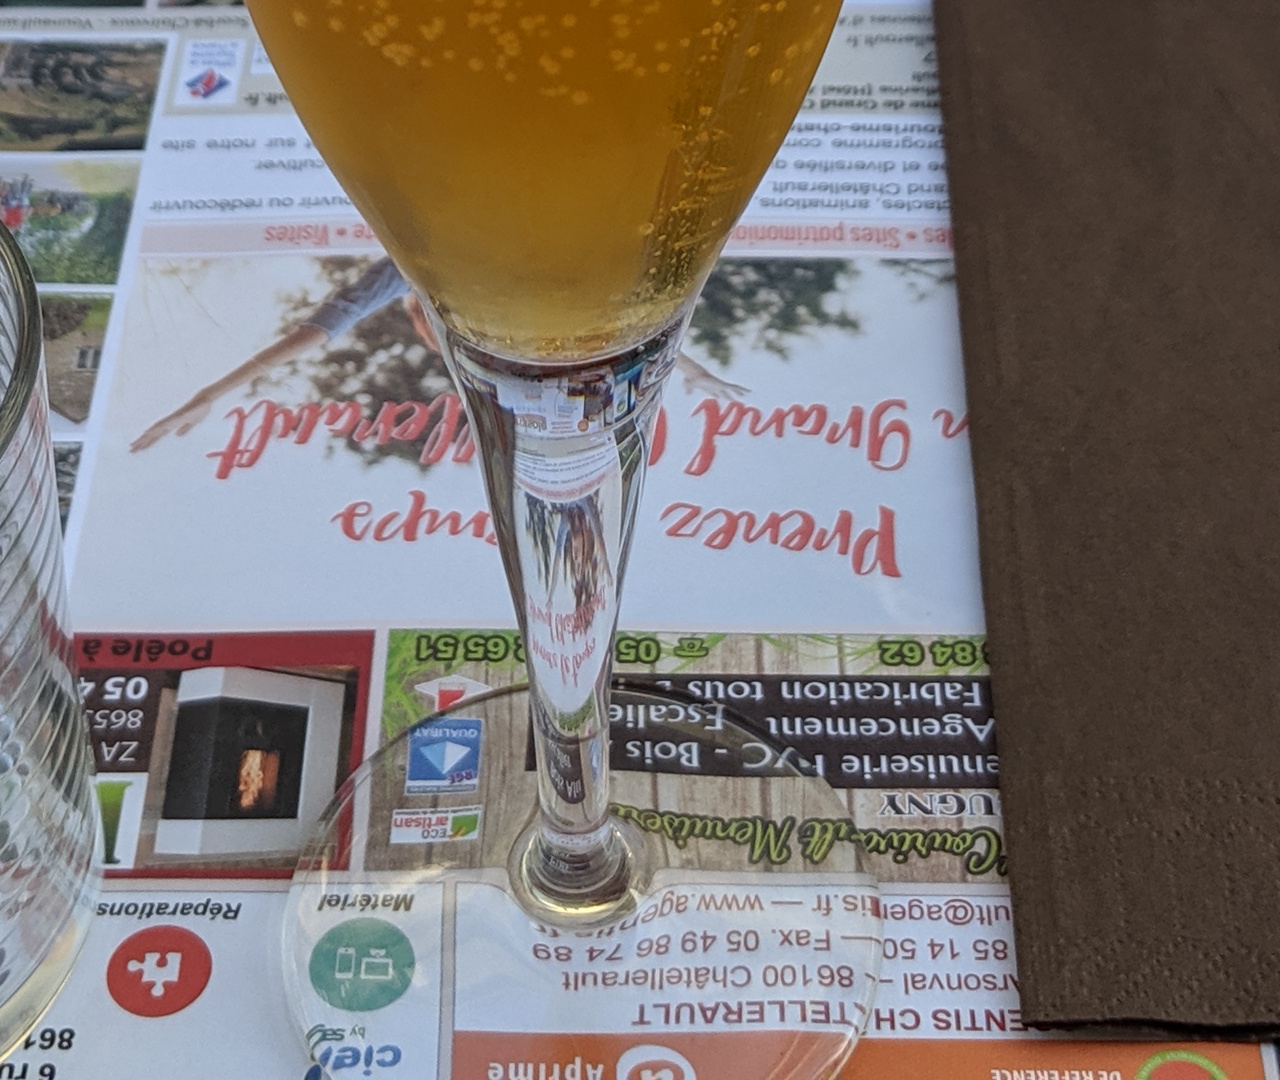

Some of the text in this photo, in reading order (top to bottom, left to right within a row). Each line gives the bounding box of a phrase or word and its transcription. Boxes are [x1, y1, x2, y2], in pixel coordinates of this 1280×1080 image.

[161, 138, 197, 152] site
[205, 137, 256, 152] notre
[789, 159, 896, 175] diversifiée
[149, 197, 264, 214] redécouvrir
[264, 224, 329, 246] Visites
[851, 227, 900, 248] Sites
[659, 501, 902, 580] Prenez
[82, 639, 214, 664] Poêle à
[415, 636, 659, 663] 05 65 51
[879, 642, 974, 666] 84 62
[104, 675, 148, 699] 05
[780, 681, 982, 707] Fabrication
[101, 740, 138, 762] ZA
[625, 739, 999, 779] enuiserie Bois
[393, 816, 449, 830] artisan
[421, 828, 447, 839] ECO
[96, 899, 242, 921] Réparations
[318, 893, 415, 914] Matériel
[531, 928, 1008, 963] 85 14 50 Fax. 05 49 86 74 89
[561, 966, 752, 992] Châtellerault
[762, 964, 854, 988] 86100
